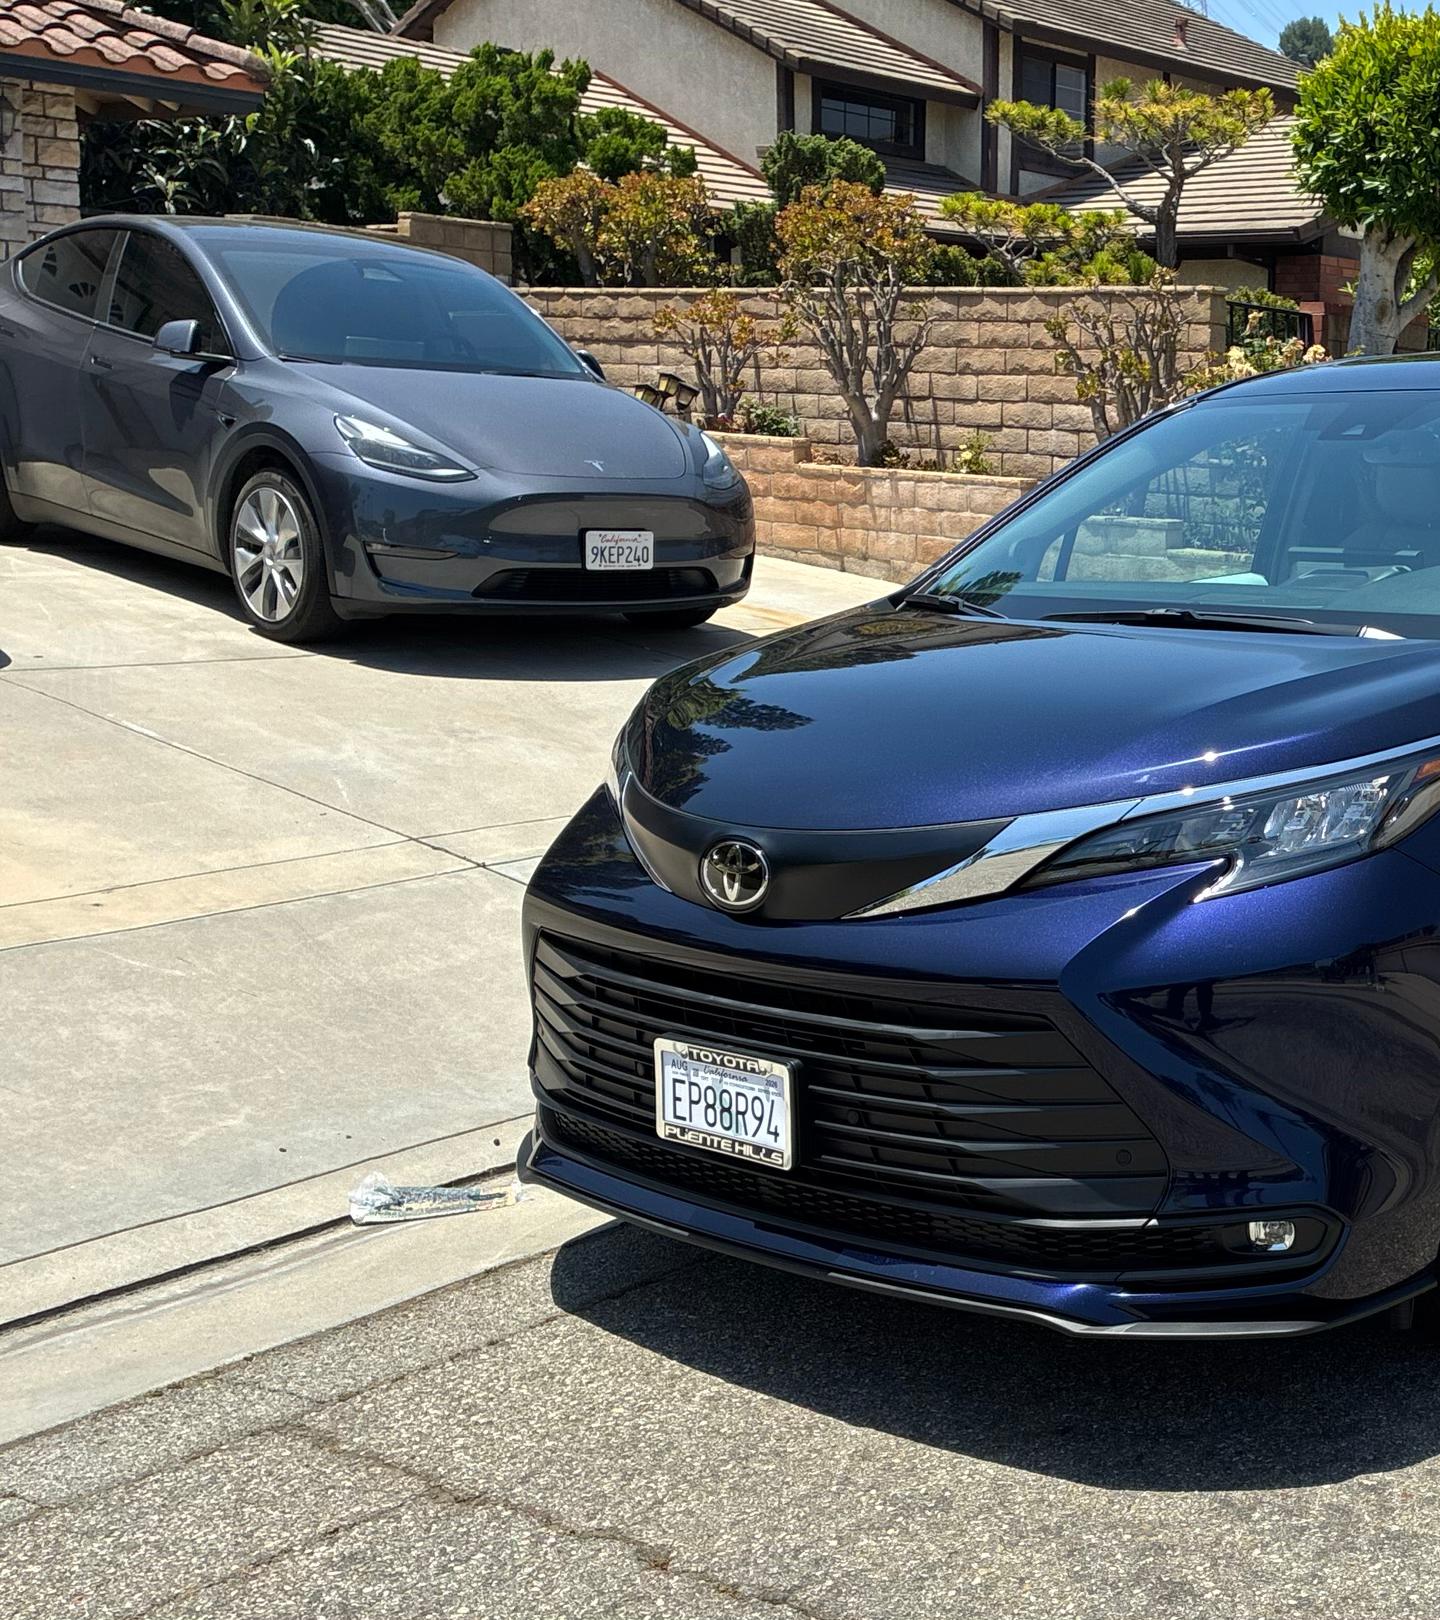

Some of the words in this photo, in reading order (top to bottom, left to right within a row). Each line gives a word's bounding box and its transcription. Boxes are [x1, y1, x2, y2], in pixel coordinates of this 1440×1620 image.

[601, 534, 641, 545] California
[591, 546, 649, 564] 9KEP240
[671, 1059, 688, 1072] AUG
[688, 1047, 760, 1073] TOYOTA
[703, 1065, 748, 1084] California
[672, 1077, 780, 1143] EP88R94
[735, 1144, 783, 1165] HILLS
